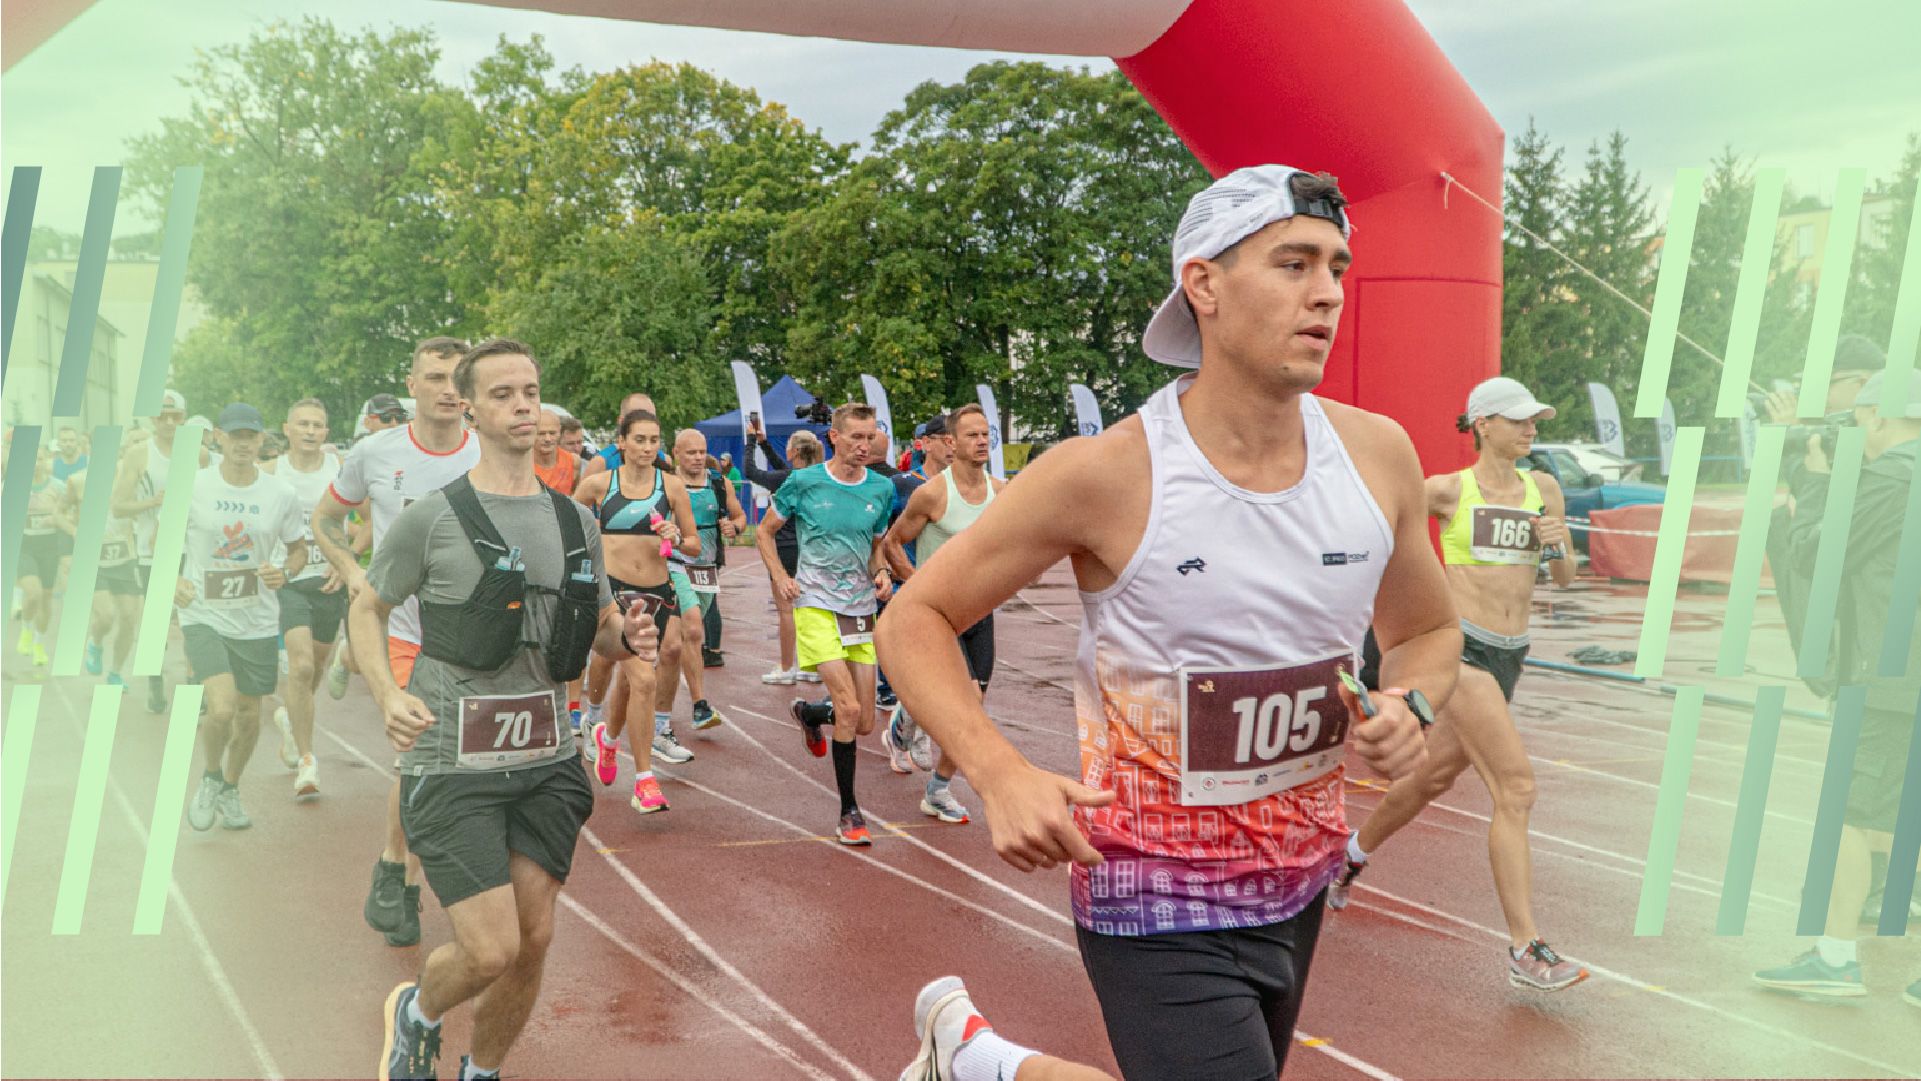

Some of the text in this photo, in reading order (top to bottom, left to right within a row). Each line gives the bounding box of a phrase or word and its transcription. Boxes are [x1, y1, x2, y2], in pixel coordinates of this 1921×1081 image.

[1491, 518, 1531, 549] 166
[221, 575, 245, 599] 27
[493, 710, 532, 748] 70
[1232, 685, 1328, 763] 105
